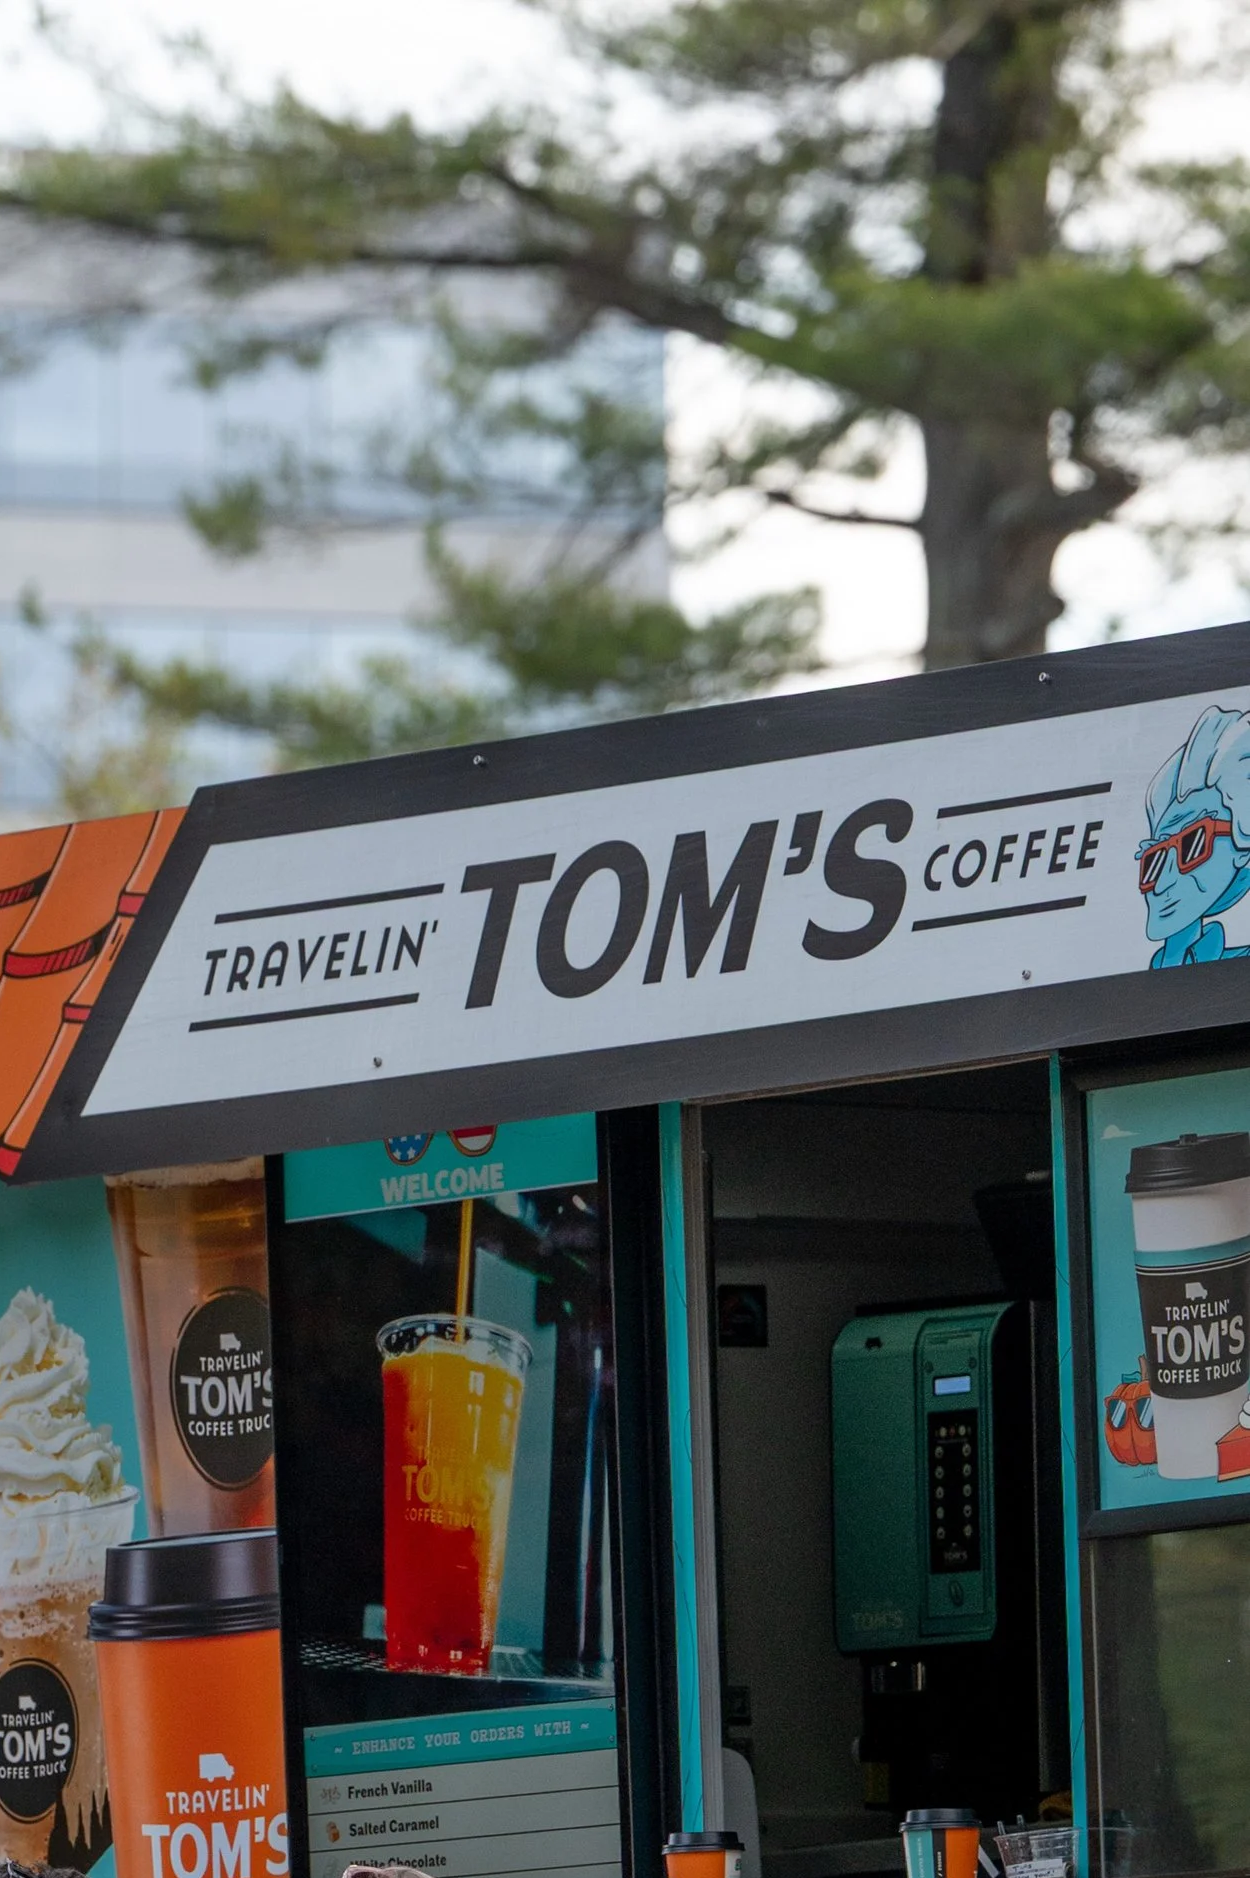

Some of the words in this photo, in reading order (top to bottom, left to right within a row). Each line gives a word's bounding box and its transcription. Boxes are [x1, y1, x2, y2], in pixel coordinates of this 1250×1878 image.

[204, 919, 439, 996] TRAVELIN'
[461, 798, 914, 1010] TOM'S
[923, 820, 1104, 892] COFFEE
[380, 1162, 505, 1204] WELCOME
[1165, 1299, 1230, 1321] TRAVELIN'
[1151, 1315, 1245, 1365] TOM'S
[199, 1350, 264, 1372] TRAVELIN'
[1158, 1368, 1200, 1384] COFFEE
[1205, 1359, 1242, 1381] TRUCK
[188, 1420, 234, 1436] COFFEE
[238, 1413, 271, 1434] TRUC
[2, 1710, 54, 1727] TRAVELIN'
[352, 1737, 415, 1756] ENHANCE
[424, 1733, 460, 1748] YOUR
[470, 1726, 524, 1743] ORDERS
[534, 1721, 571, 1737] WITH
[33, 1760, 66, 1777] TRUCK
[166, 1784, 270, 1814] TRAVELIN'
[348, 1783, 388, 1799] French
[392, 1779, 432, 1795] Vanilla
[349, 1820, 387, 1837] Salted
[389, 1816, 439, 1832] Caramel
